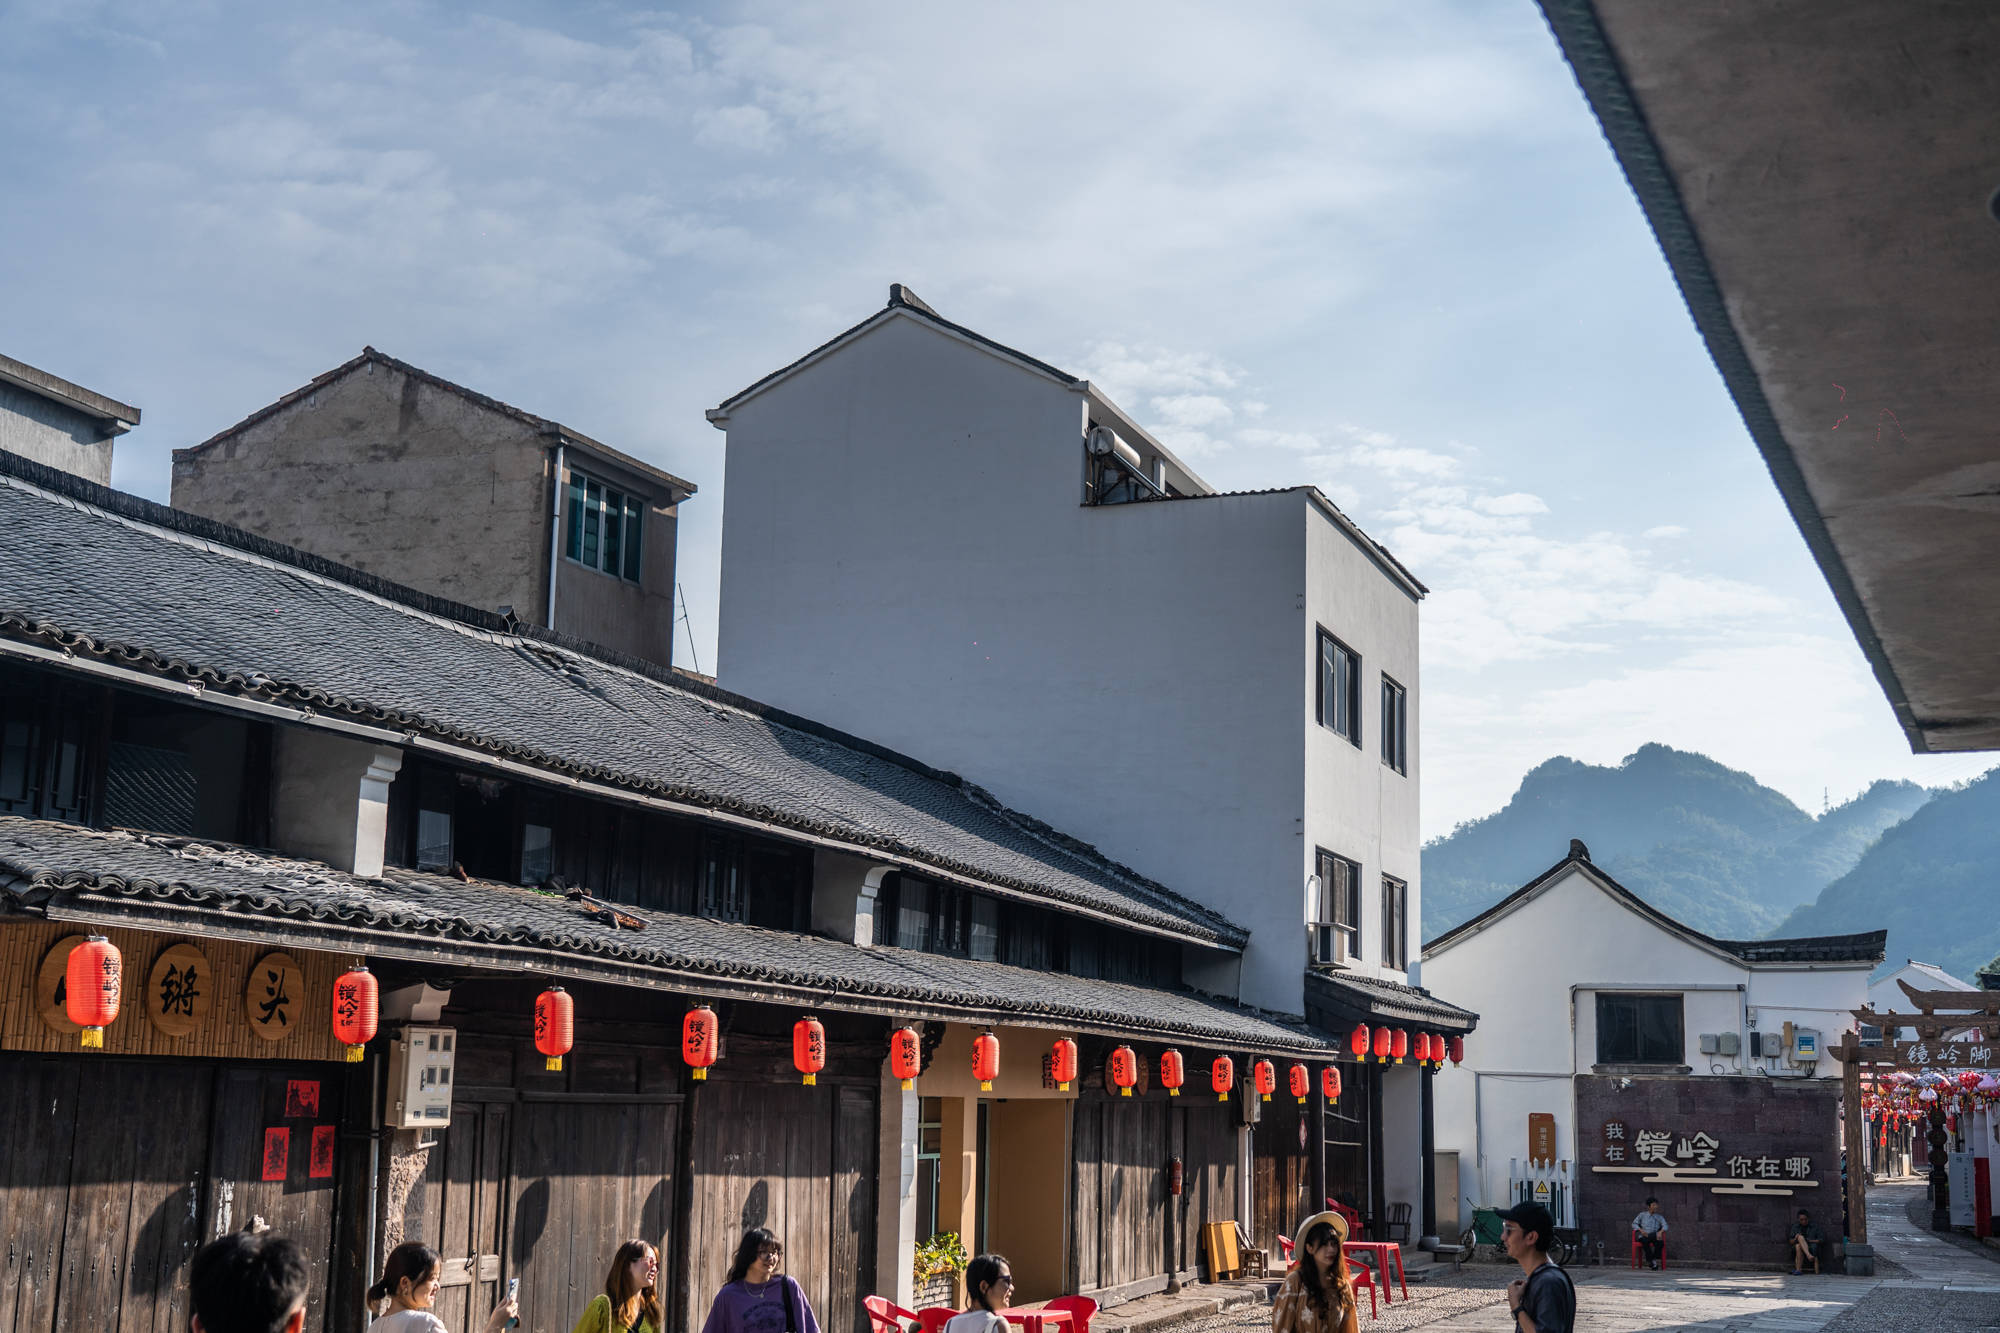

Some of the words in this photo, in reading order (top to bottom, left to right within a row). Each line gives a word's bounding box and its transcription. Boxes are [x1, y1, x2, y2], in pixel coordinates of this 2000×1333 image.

[1605, 1123, 1624, 1162] 我在
[1634, 1129, 1719, 1167] 镜岭
[1726, 1155, 1811, 1178] 你在哪
